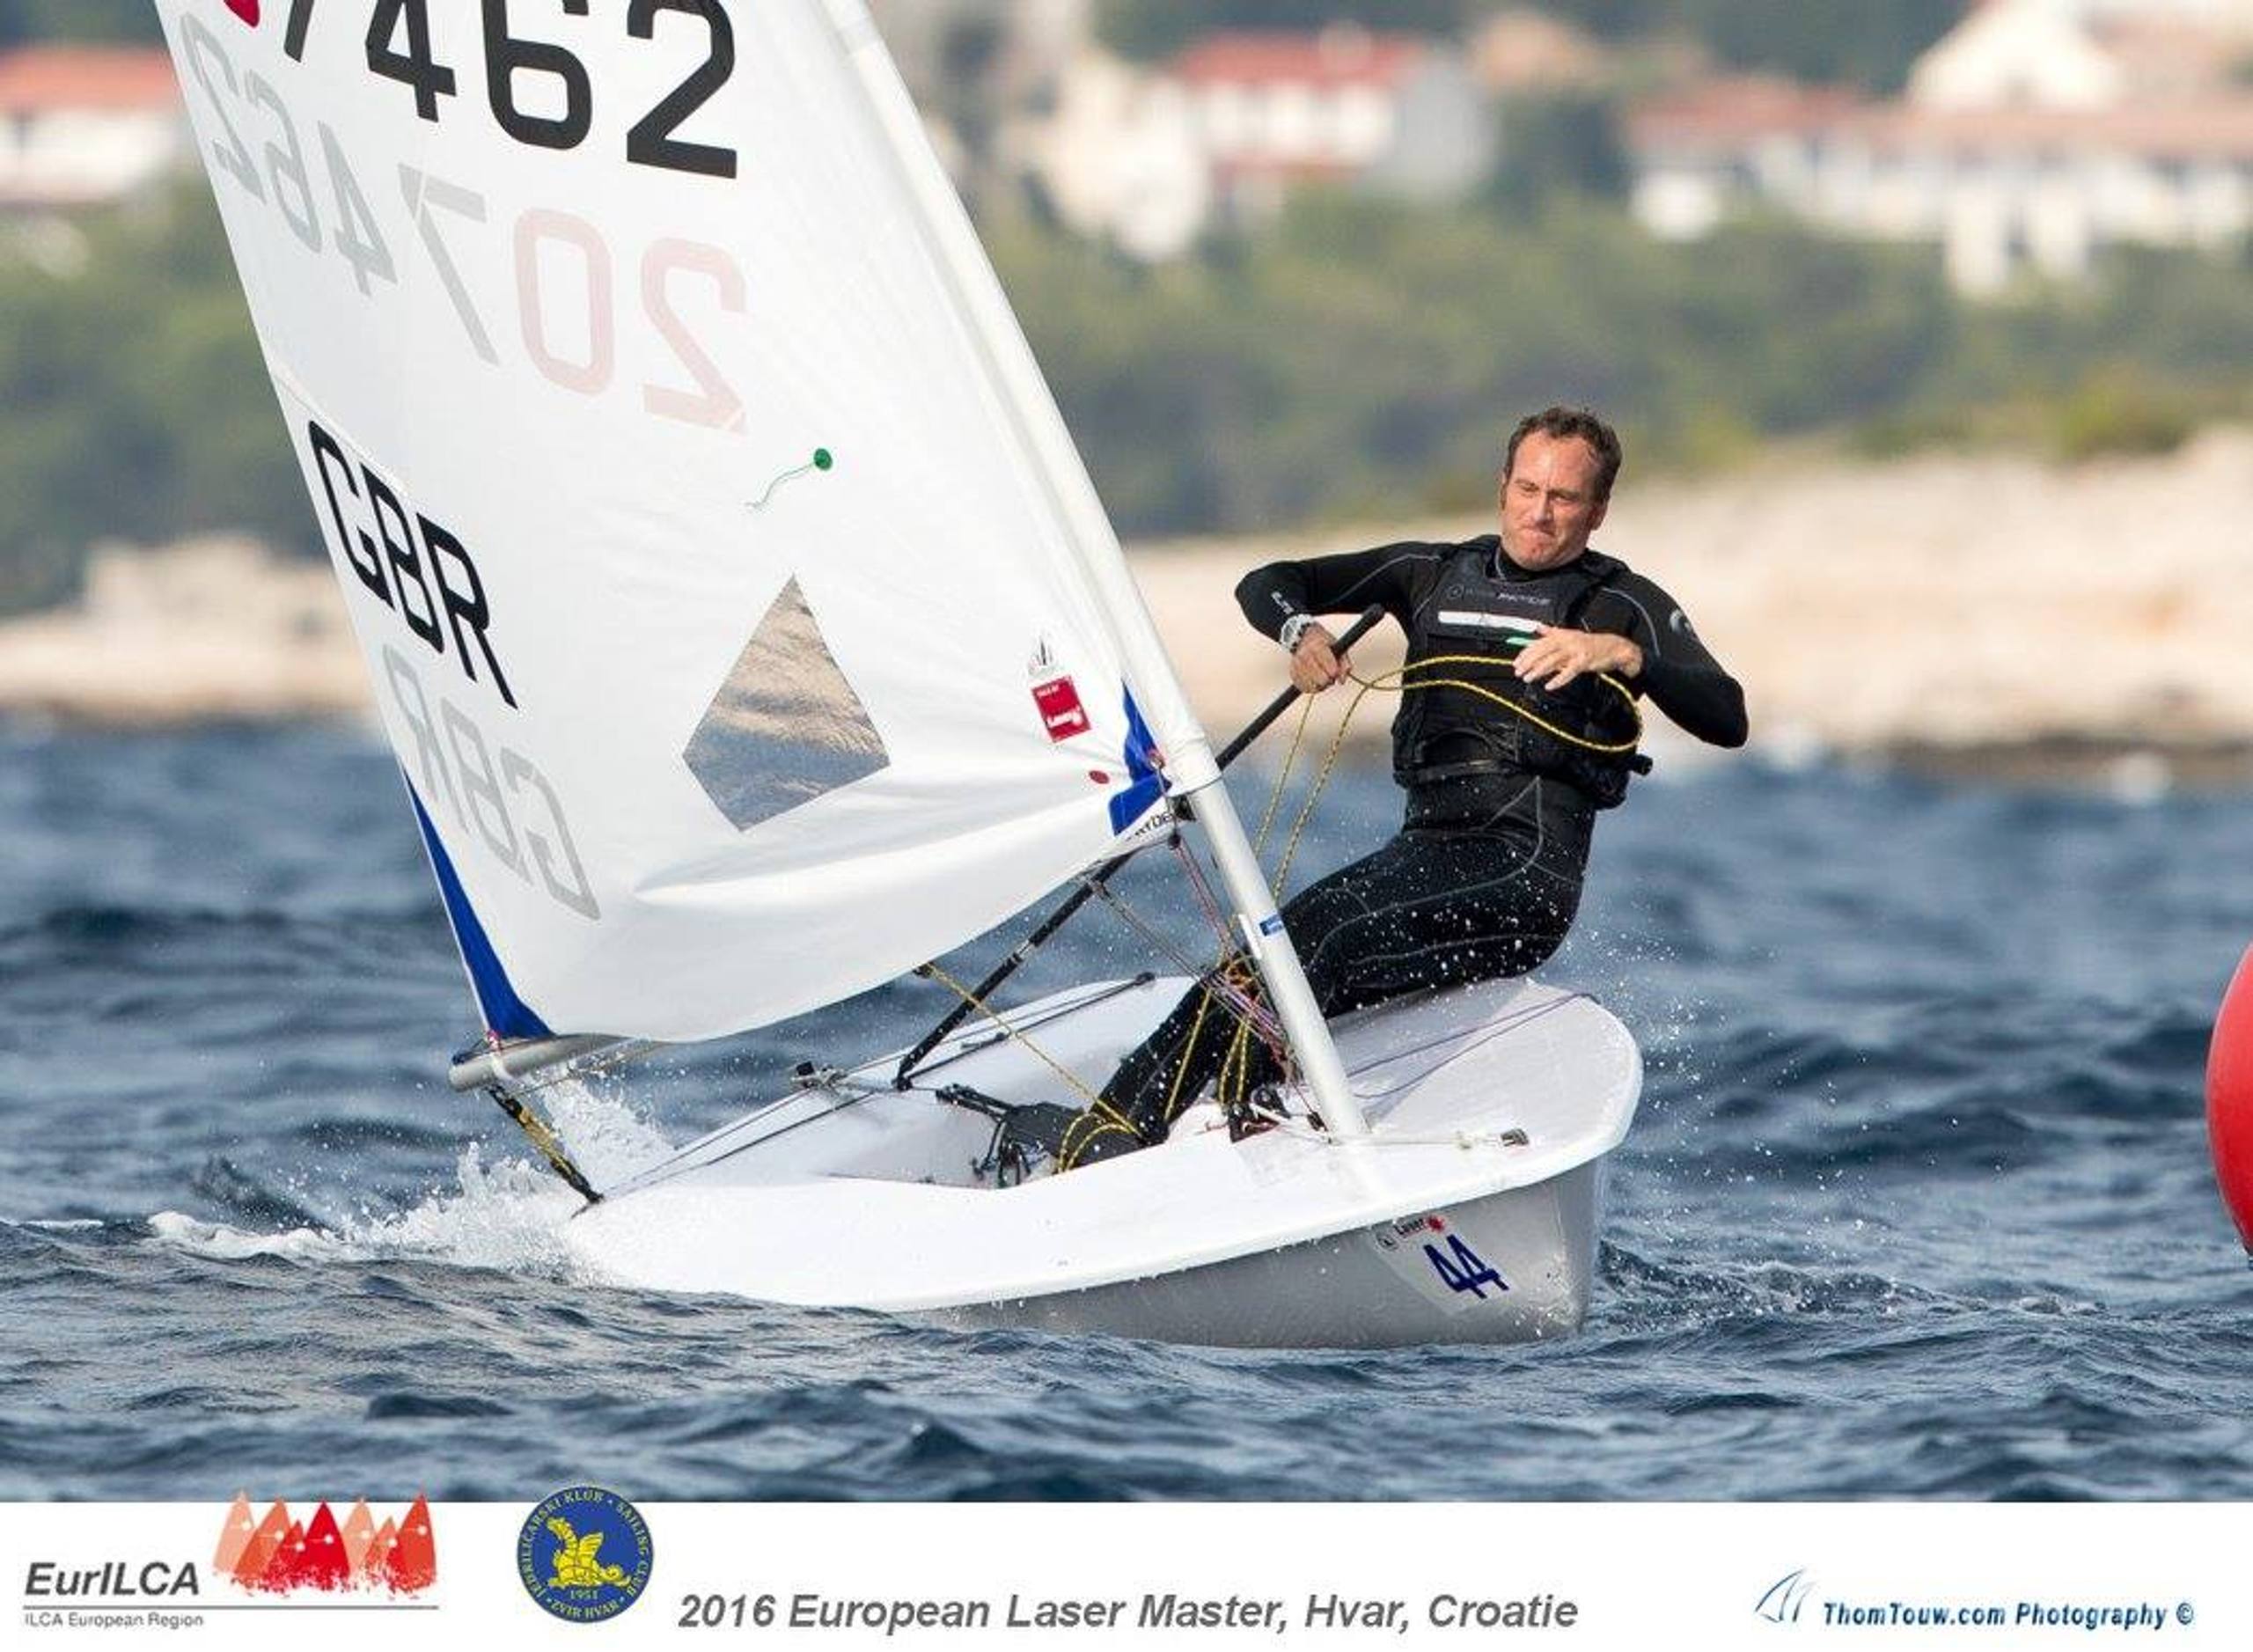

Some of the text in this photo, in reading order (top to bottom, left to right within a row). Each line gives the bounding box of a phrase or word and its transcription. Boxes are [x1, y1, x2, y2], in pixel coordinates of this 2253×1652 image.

[226, 0, 738, 179] 462
[308, 420, 519, 709] GBR
[1422, 1234, 1510, 1300] 44
